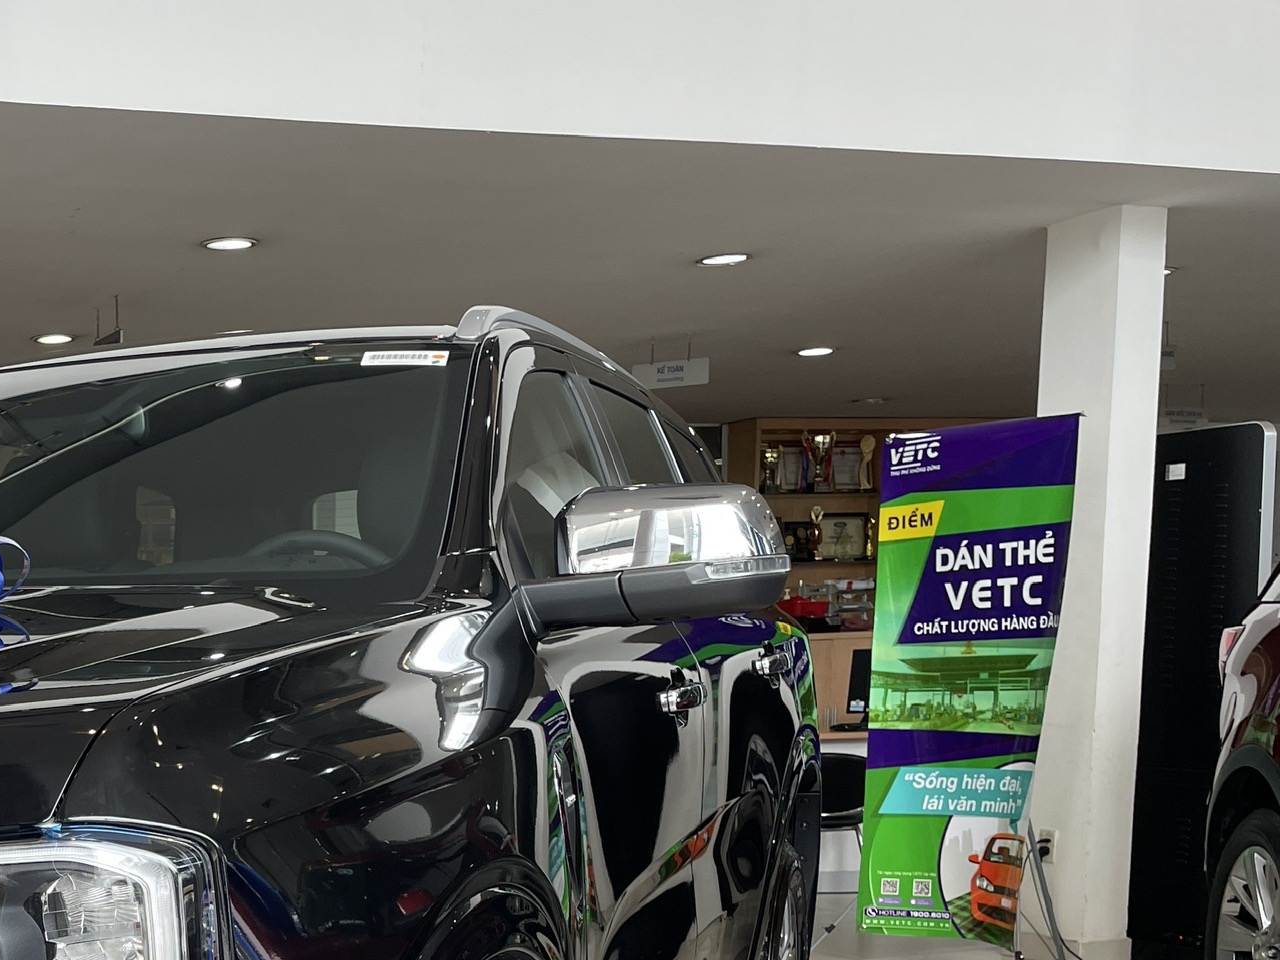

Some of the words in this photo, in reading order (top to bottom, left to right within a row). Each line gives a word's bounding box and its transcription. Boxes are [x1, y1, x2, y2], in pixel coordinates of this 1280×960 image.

[890, 441, 941, 465] VETC
[887, 507, 933, 530] ĐIỂM
[935, 540, 993, 572] DÁN
[999, 530, 1055, 567] THẺ
[944, 575, 1043, 611] VETC
[914, 617, 948, 635] CHẤT
[950, 617, 999, 636] LƯỢNG
[1001, 614, 1037, 631] HÀNG
[962, 773, 995, 793] hiện
[922, 795, 945, 811] lái
[948, 796, 976, 812] văn
[879, 909, 908, 917] HOTLINE
